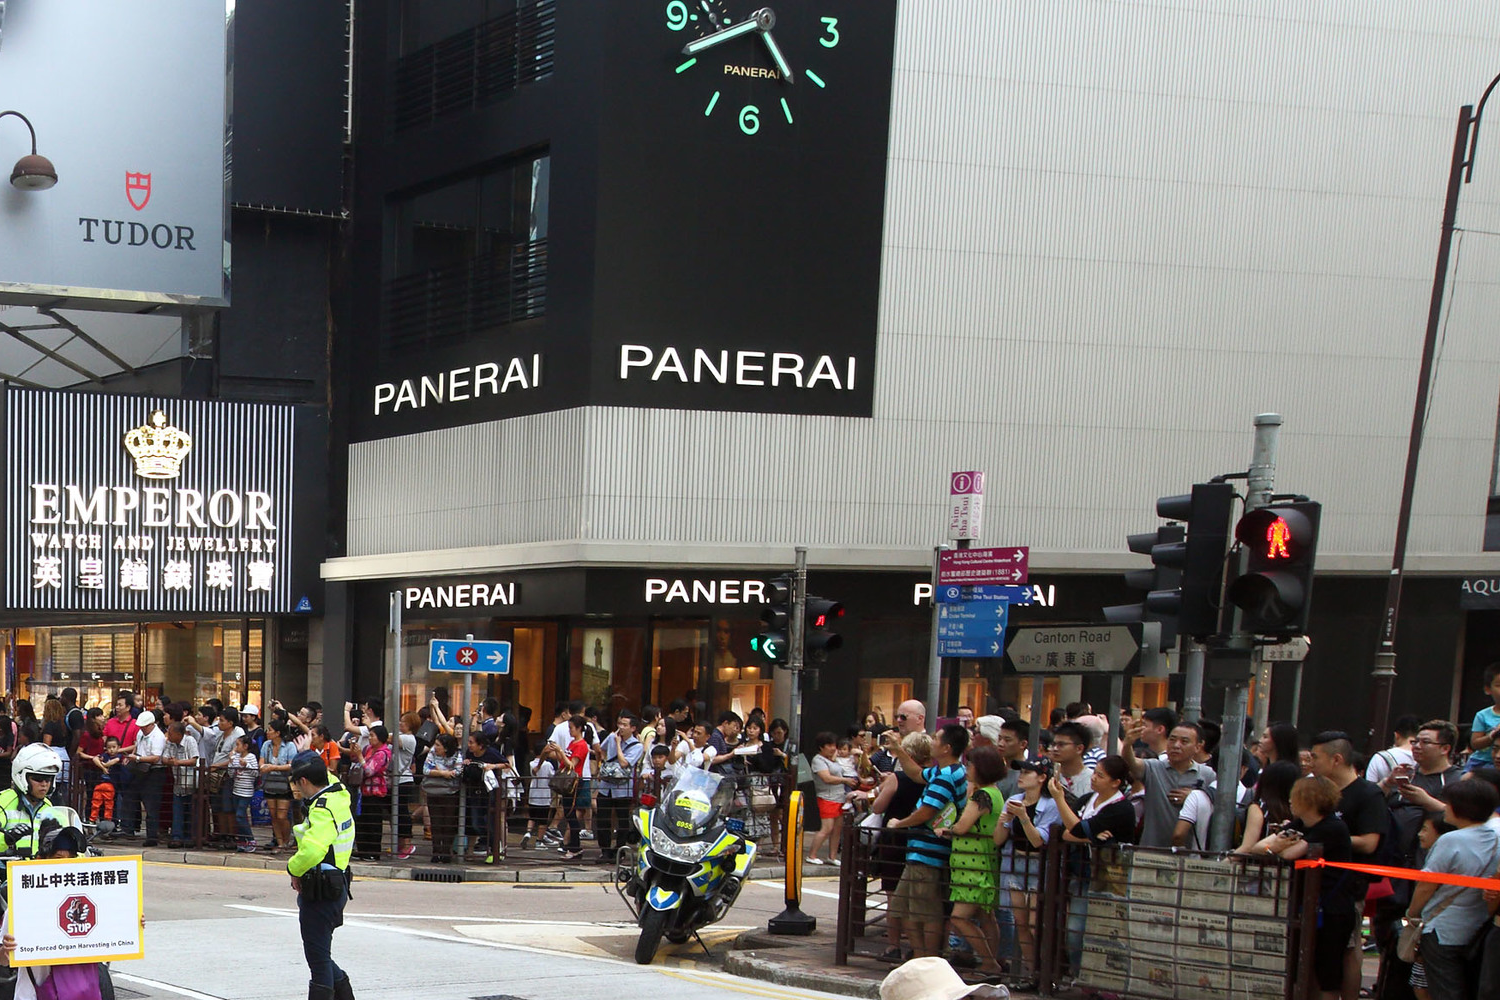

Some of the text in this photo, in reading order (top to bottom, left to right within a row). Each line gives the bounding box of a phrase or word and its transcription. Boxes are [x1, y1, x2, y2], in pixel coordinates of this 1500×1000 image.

[819, 17, 840, 48] 3
[724, 64, 781, 80] PANERAI
[739, 105, 760, 135] 6
[78, 217, 197, 252] TUDOR
[619, 344, 857, 390] PANERAI
[374, 353, 541, 415] PANERAI
[30, 483, 277, 530] EMPEROR
[951, 506, 960, 530] Tsim
[959, 497, 969, 537] Sha Tsui
[30, 532, 276, 553] WATCH AND JEWELLERY
[406, 583, 516, 609] PANERAI
[645, 579, 770, 604] PANER
[1034, 630, 1111, 645] Canton Road
[1044, 651, 1095, 667] 廣東道
[676, 820, 693, 830] 6955
[21, 870, 130, 889] 制止中共活摘器官
[36, 944, 57, 952] Forced
[58, 943, 76, 951] Organ
[78, 942, 110, 950] Harvesting
